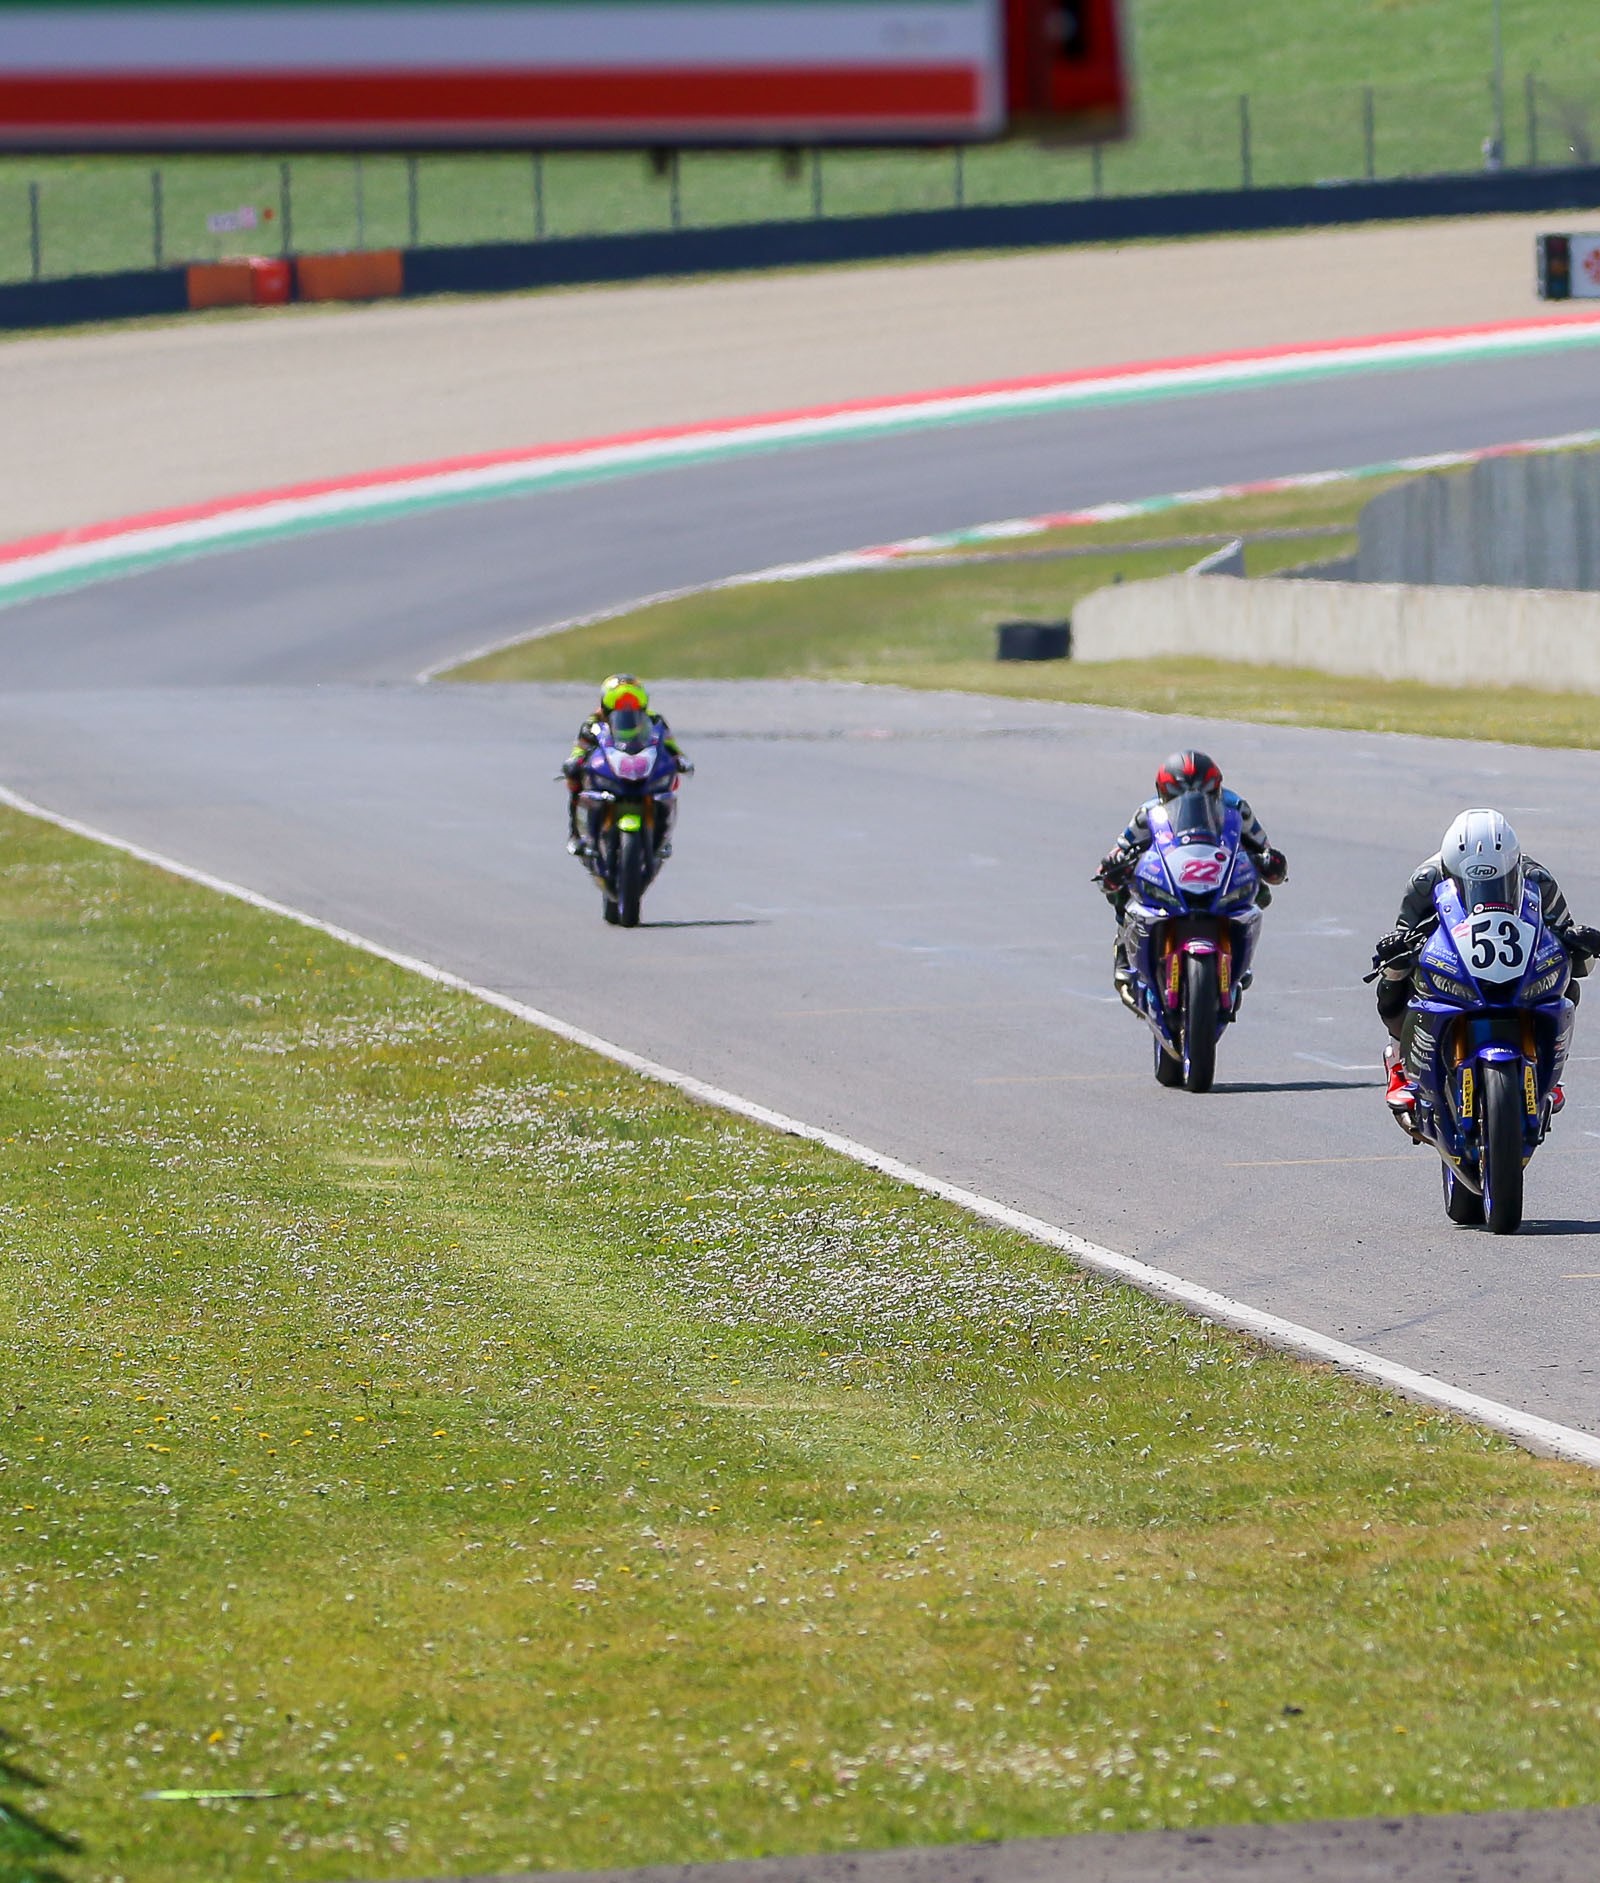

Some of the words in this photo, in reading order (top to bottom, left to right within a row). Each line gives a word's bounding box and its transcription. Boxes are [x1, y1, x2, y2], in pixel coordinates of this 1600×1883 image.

[1181, 860, 1222, 884] 22
[1470, 866, 1494, 877] Arai
[1471, 919, 1524, 969] 53
